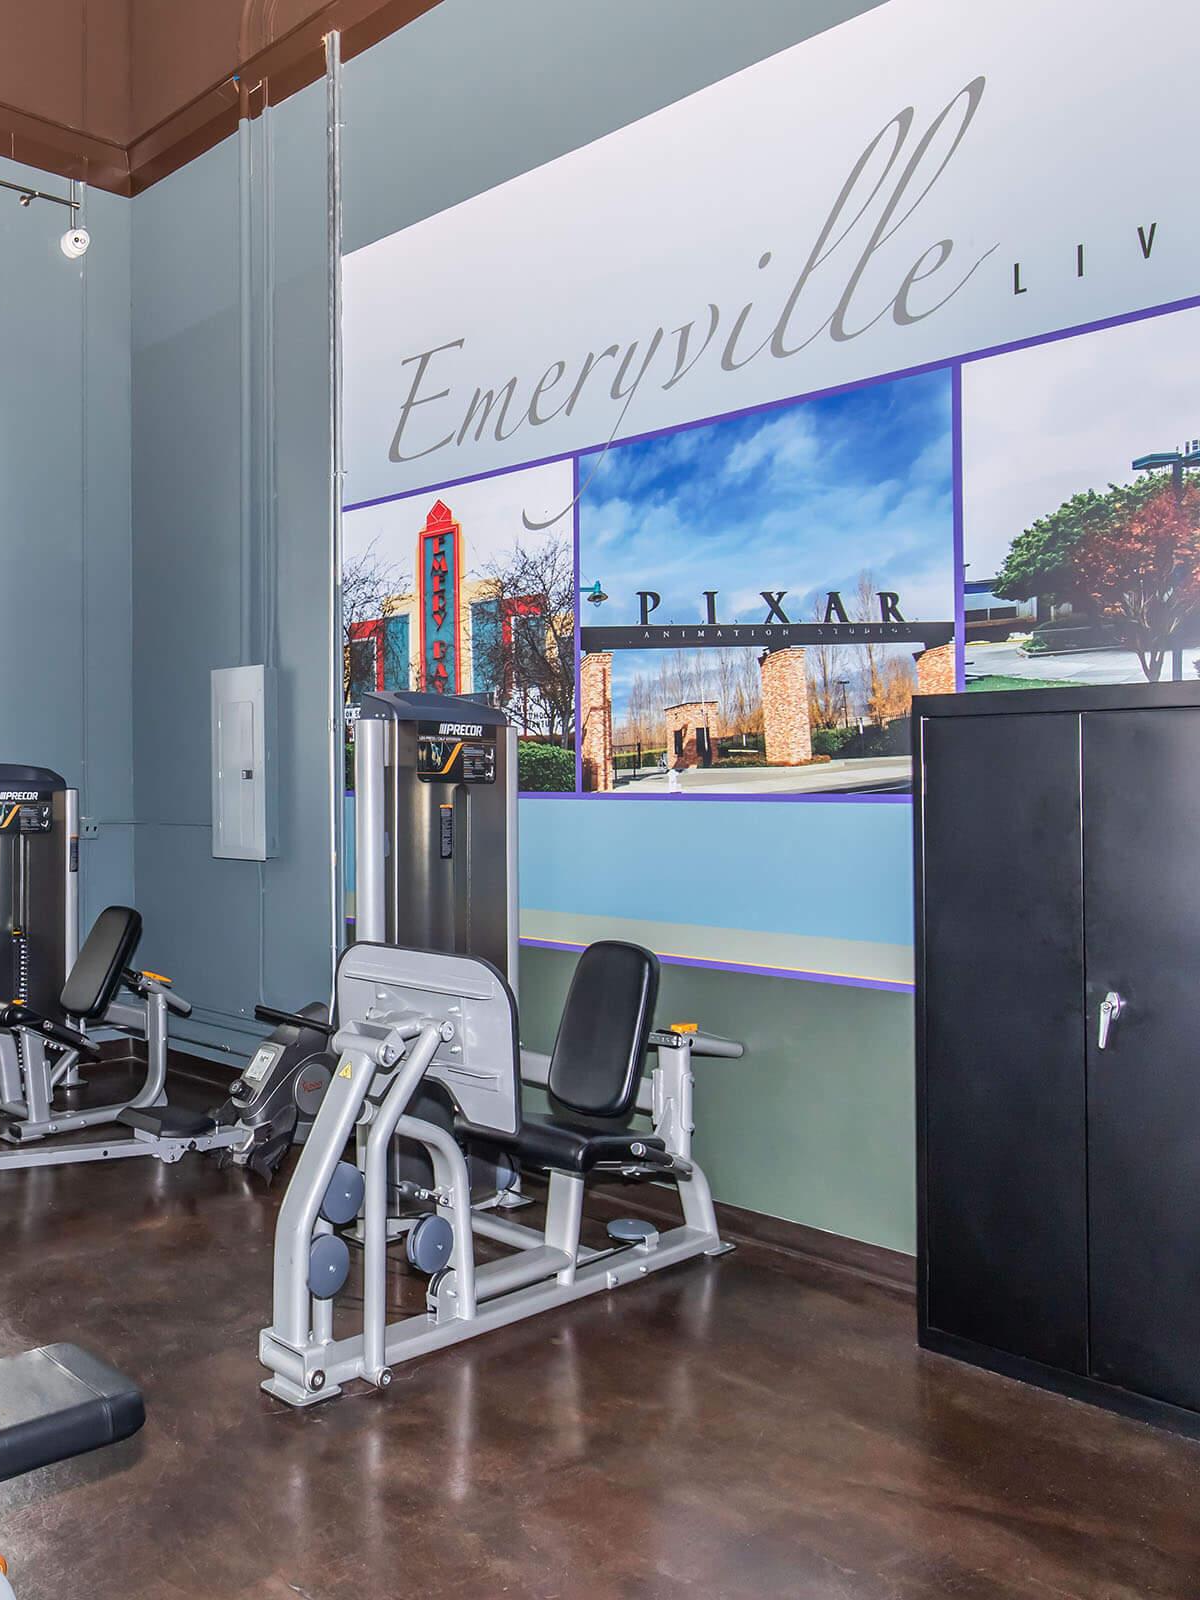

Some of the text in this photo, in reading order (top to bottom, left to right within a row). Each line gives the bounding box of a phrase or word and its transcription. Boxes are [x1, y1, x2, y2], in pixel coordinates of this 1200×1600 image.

[388, 76, 1000, 530] Emeryville
[431, 536, 449, 632] EMERY
[636, 591, 906, 626] PIXAR
[642, 629, 790, 640] ANIMATION
[446, 724, 483, 737] PRECOR
[5, 792, 39, 800] PRECOR
